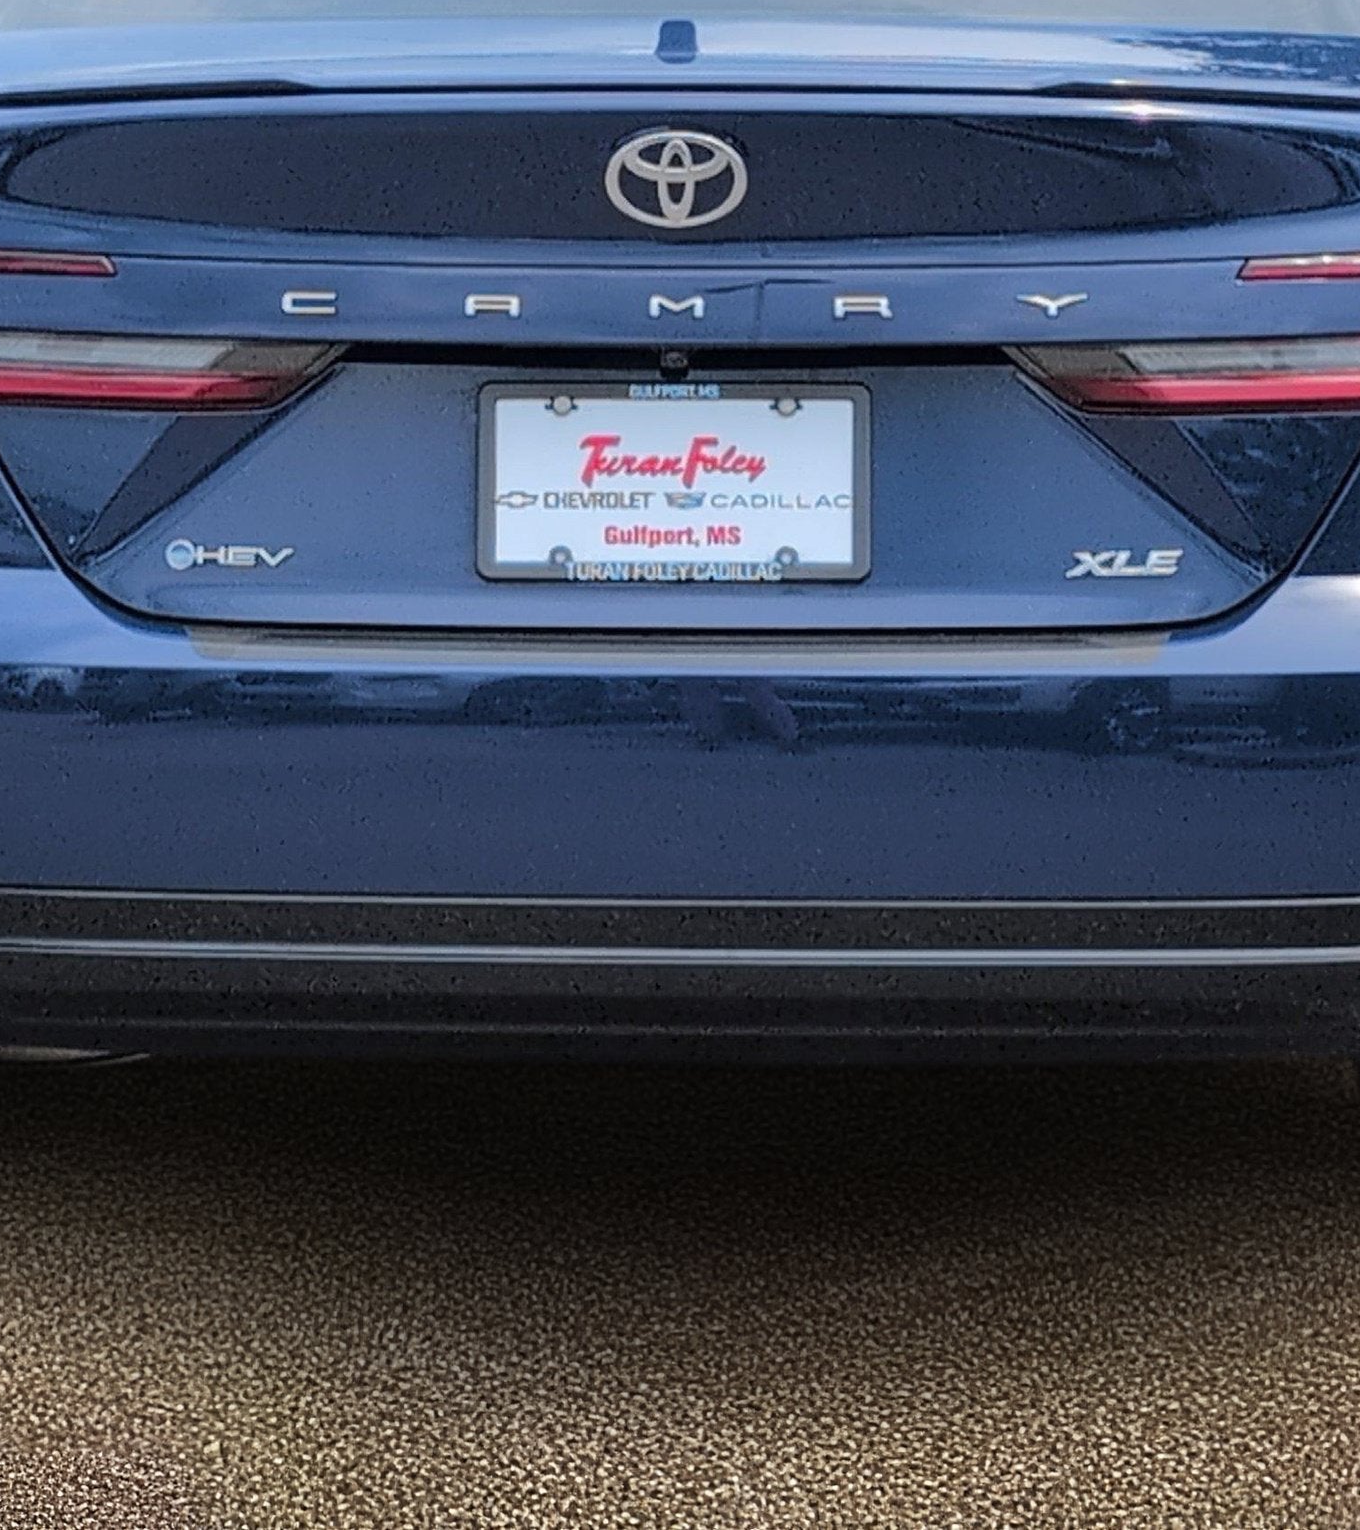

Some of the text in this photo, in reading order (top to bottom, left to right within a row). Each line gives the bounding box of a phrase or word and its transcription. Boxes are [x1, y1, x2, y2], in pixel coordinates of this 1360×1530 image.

[281, 289, 1090, 320] CAMRY
[543, 492, 853, 511] CHEVROLET CADILLAC
[604, 525, 742, 548] Gulfport, MS
[566, 561, 783, 581] TURAN FOLEY CADILLAC
[1065, 549, 1184, 579] XLE
